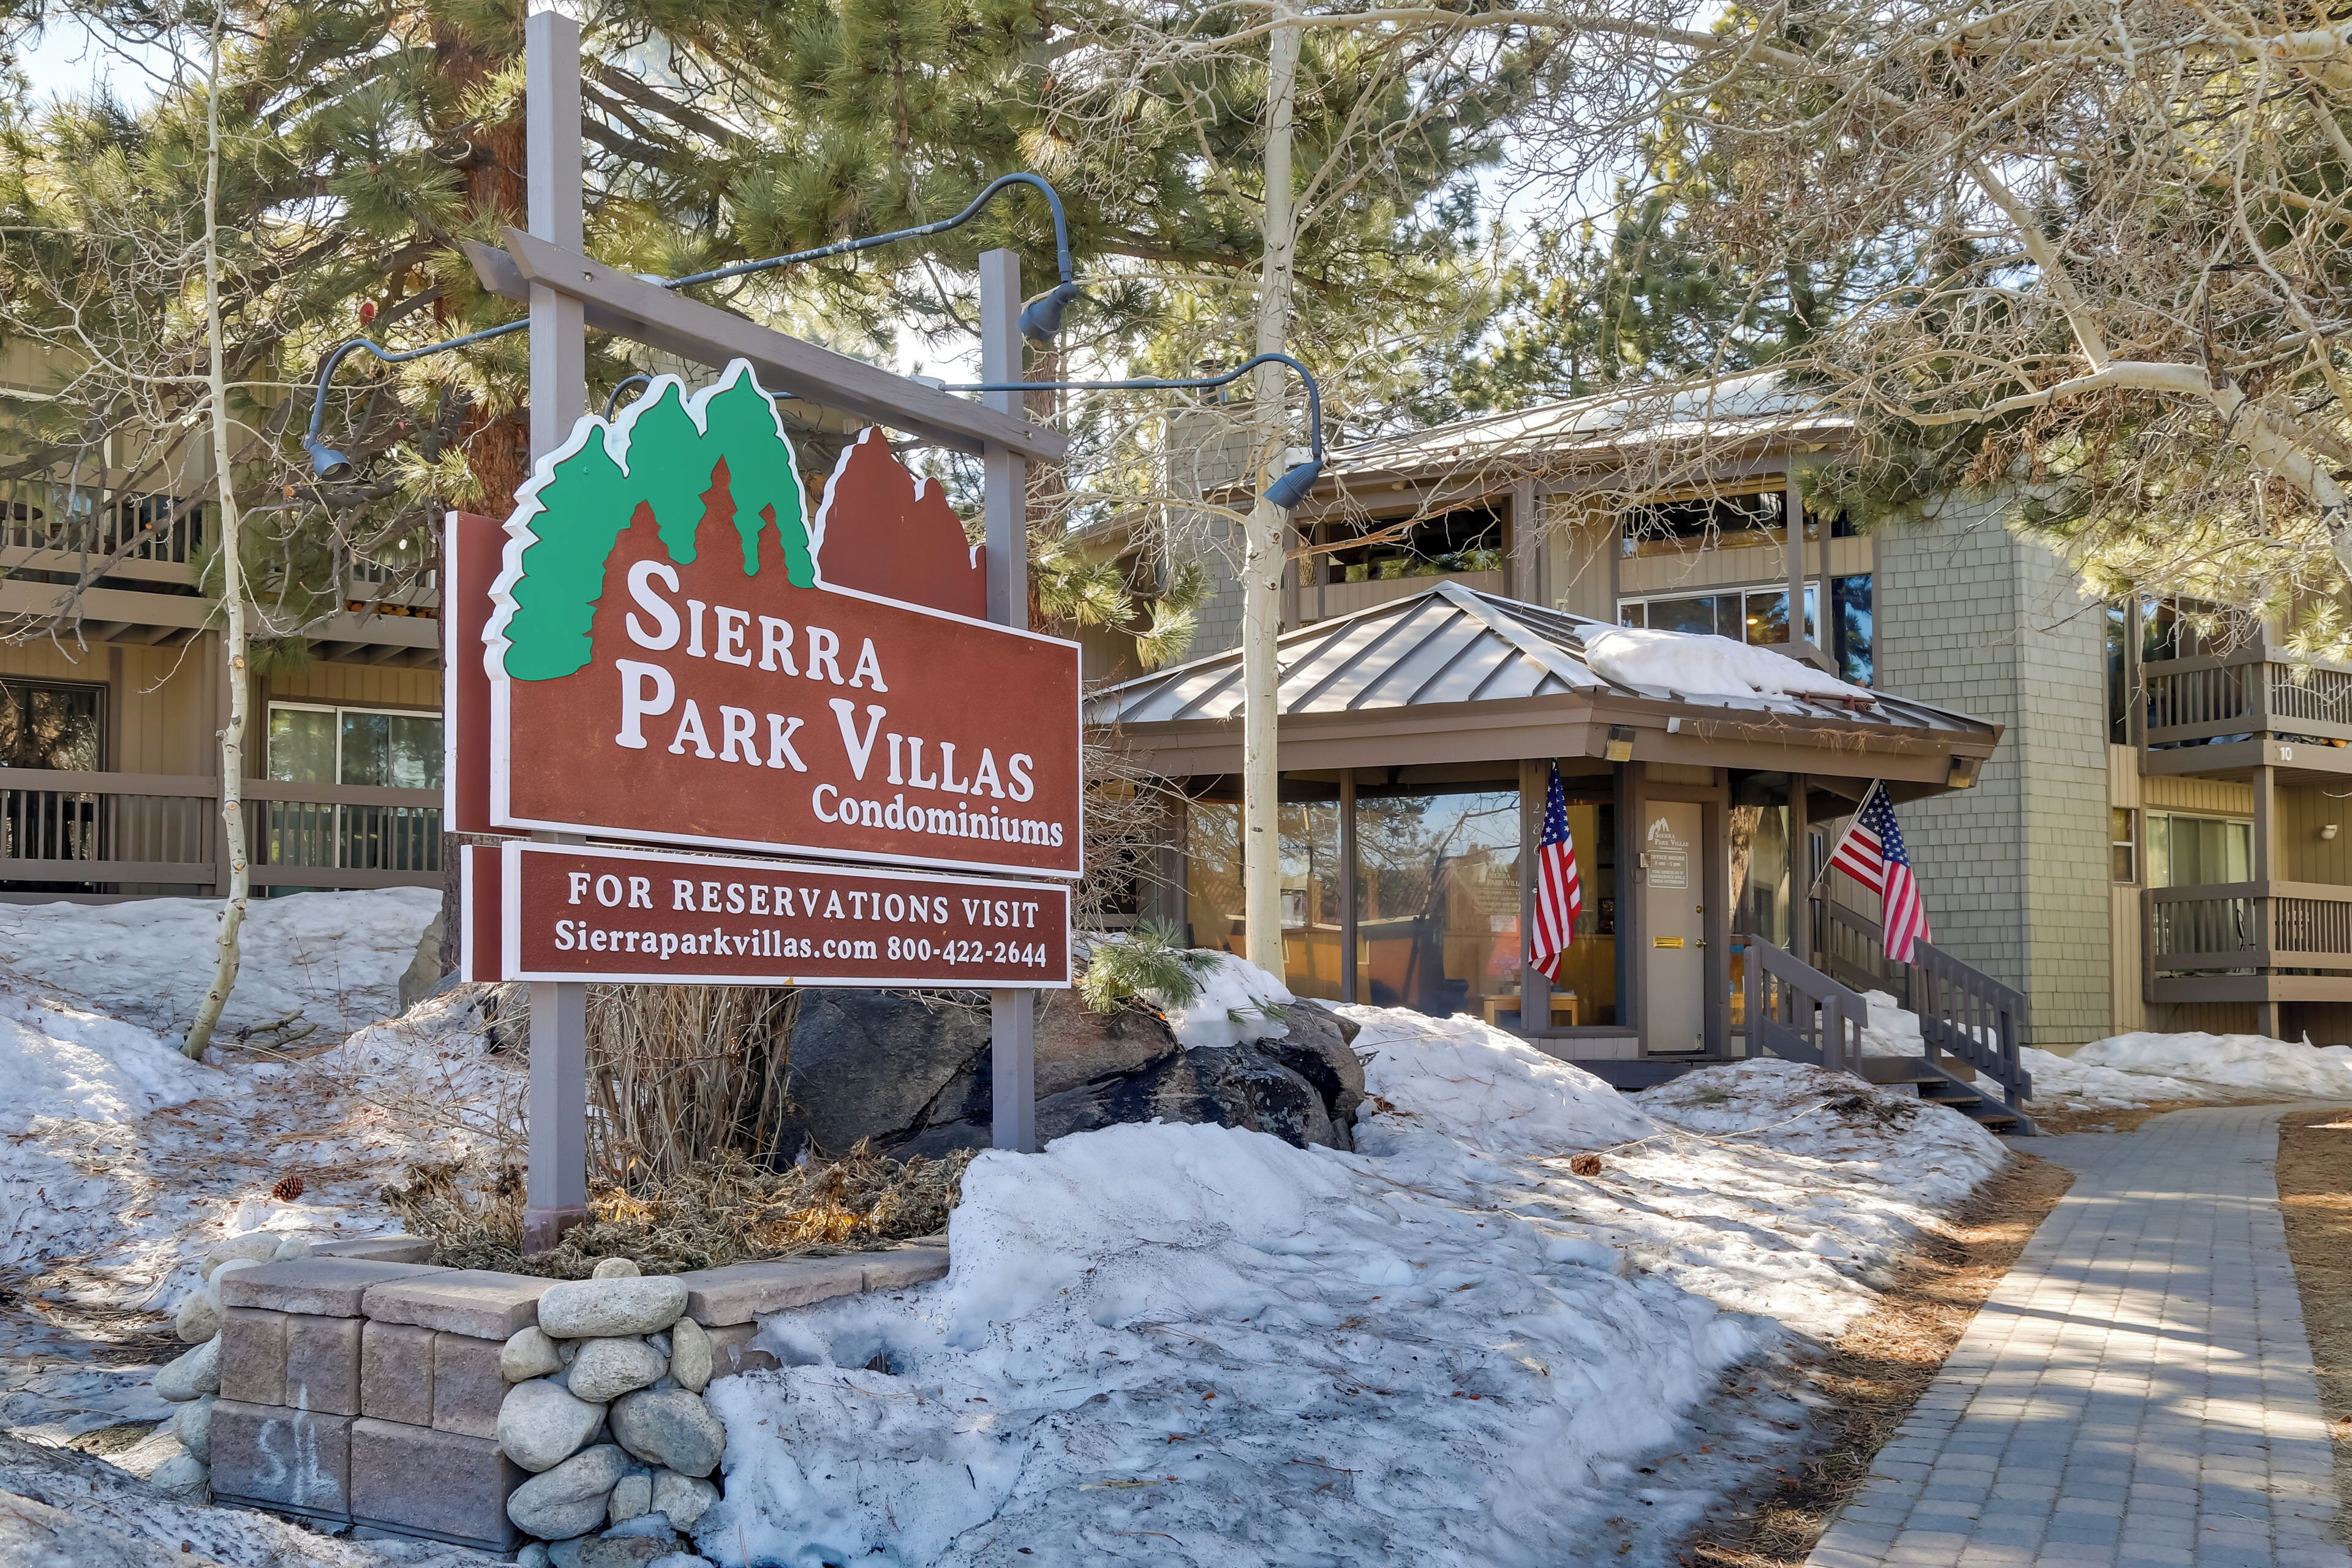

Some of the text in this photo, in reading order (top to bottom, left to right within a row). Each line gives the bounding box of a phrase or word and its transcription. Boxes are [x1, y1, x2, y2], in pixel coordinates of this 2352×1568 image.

[625, 560, 889, 693] SIERRA
[615, 658, 1035, 803] PARK VILLAS
[2279, 747, 2292, 761] 10
[812, 783, 1064, 847] Condominiums
[568, 872, 1039, 928] FOR RESERVATIONS VISIT
[555, 919, 1046, 968] Sierraparkvillas.com 800-422-2644
